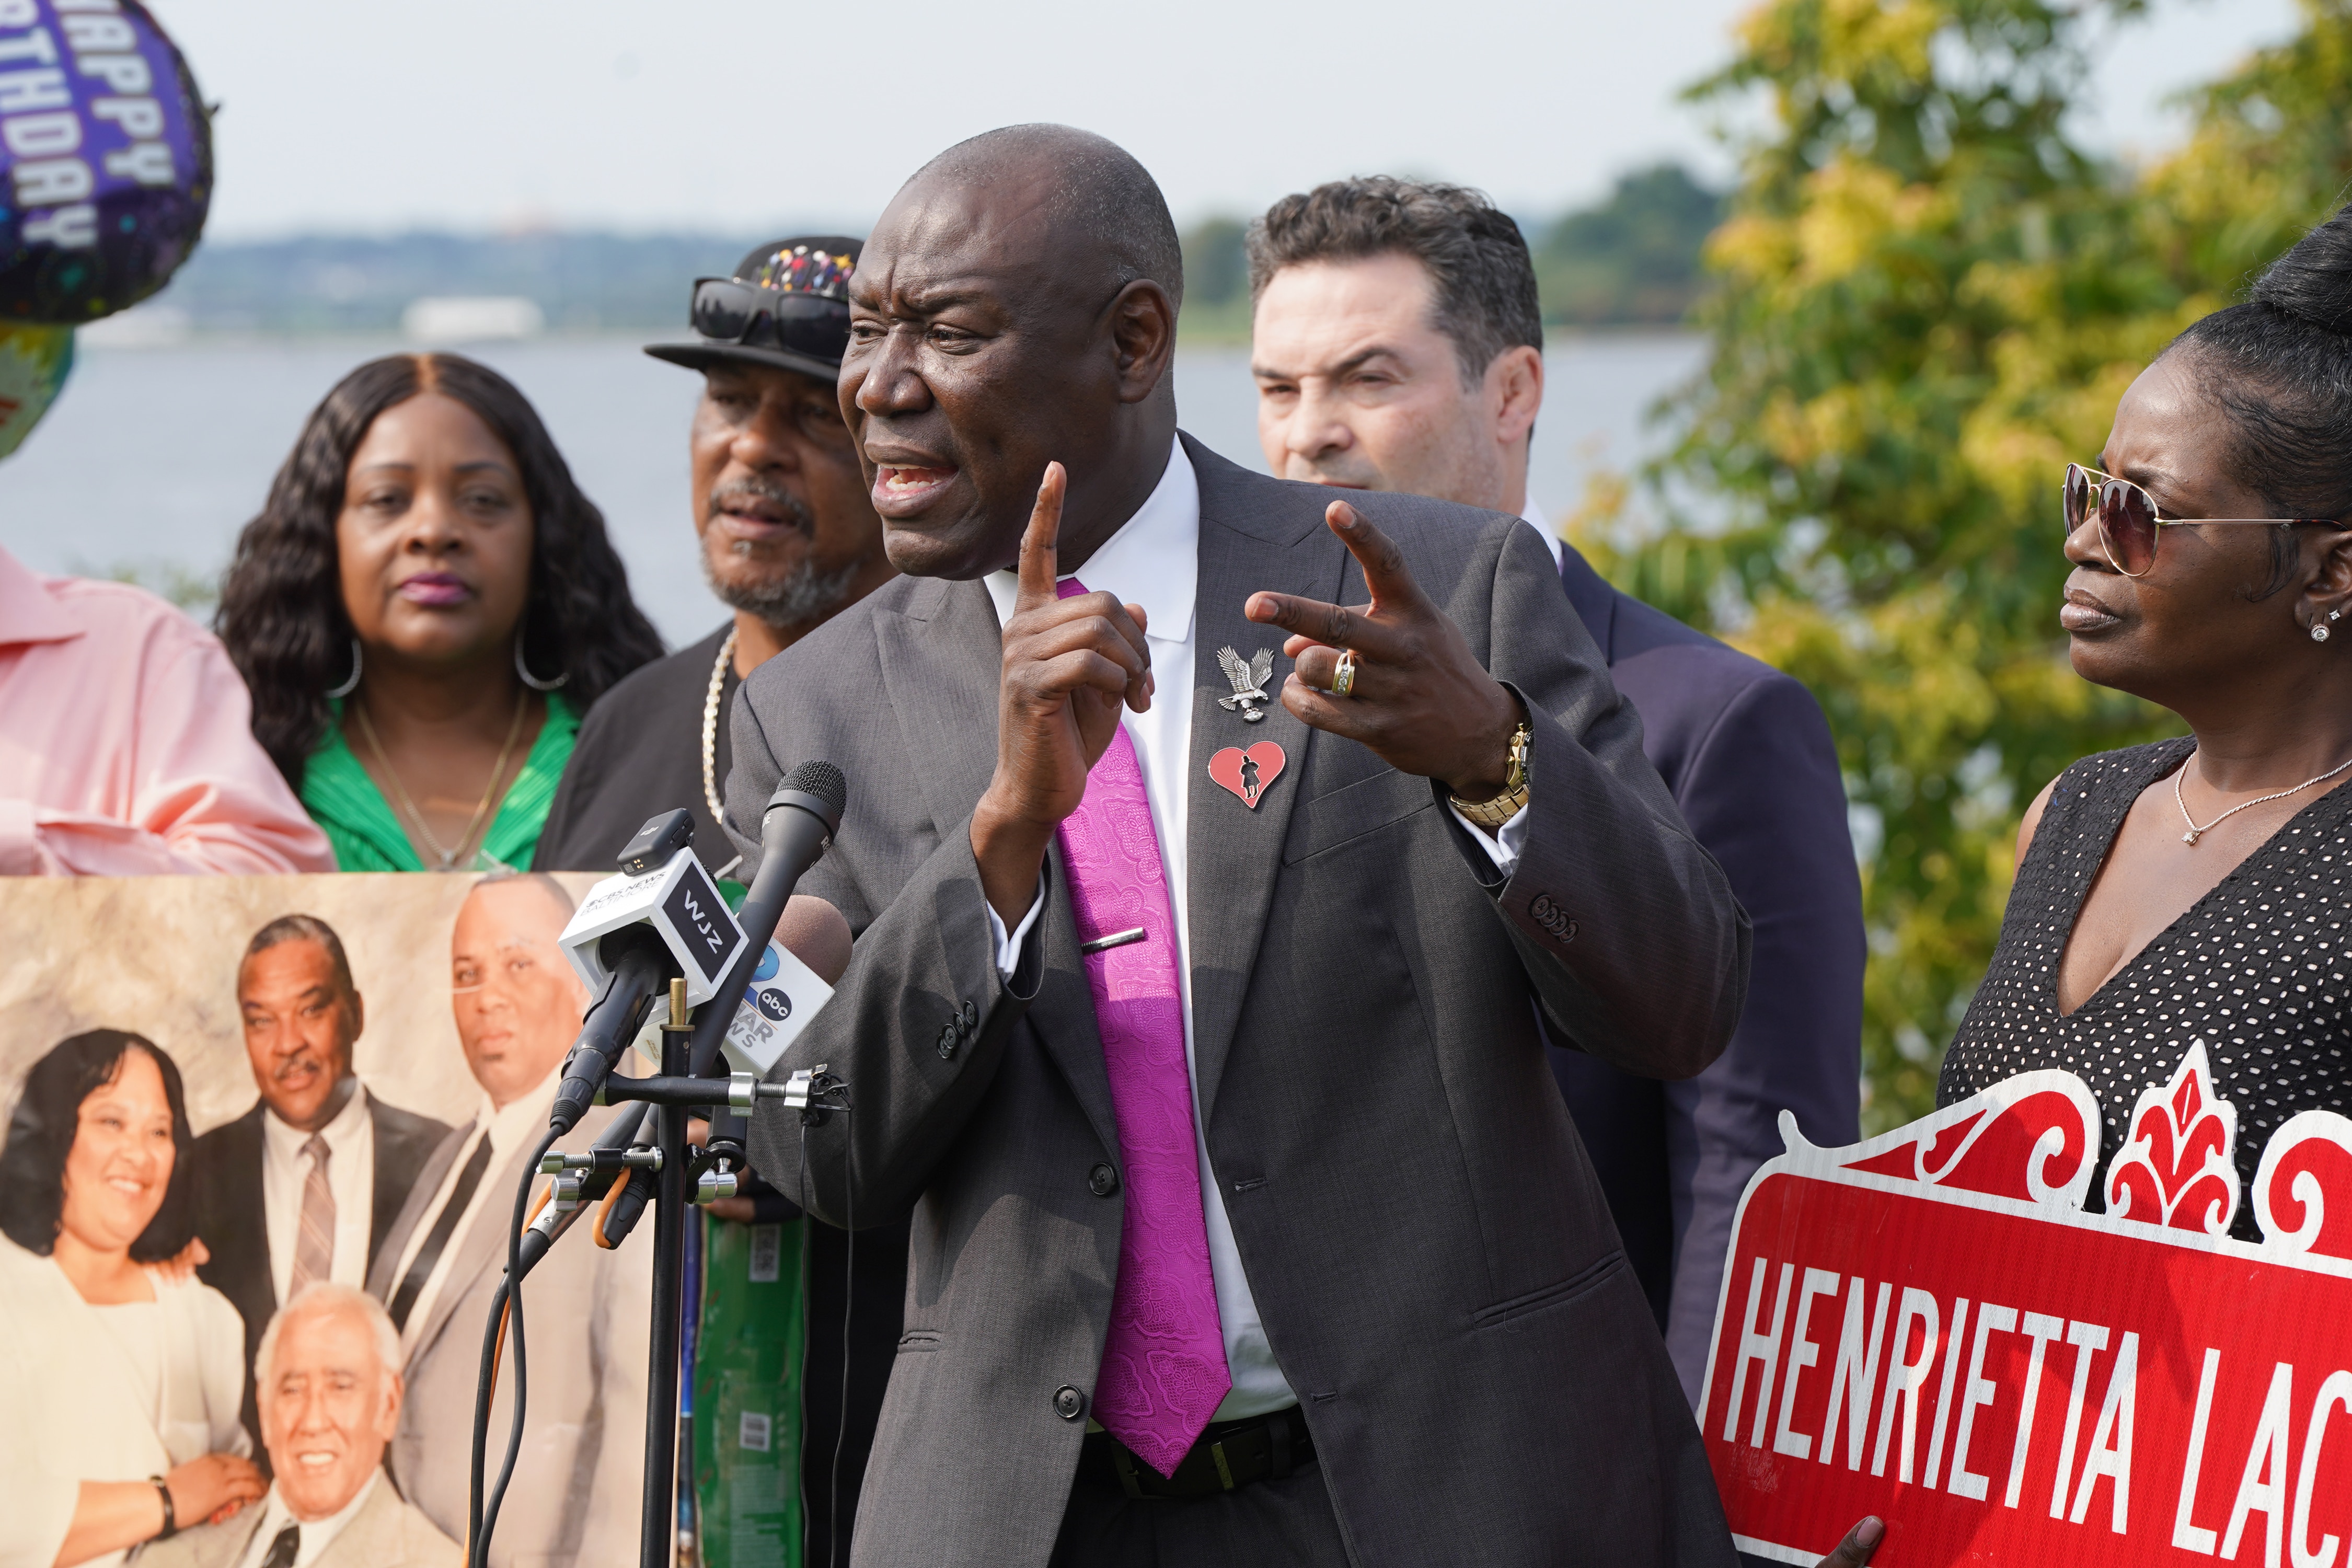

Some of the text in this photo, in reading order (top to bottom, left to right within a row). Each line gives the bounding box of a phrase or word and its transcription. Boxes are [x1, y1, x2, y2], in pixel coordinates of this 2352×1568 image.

[580, 881, 660, 916] BALTIMORE
[598, 871, 666, 903] CBS NEWS
[684, 889, 723, 954] WJZ
[762, 993, 788, 1017] abc
[1722, 1256, 2352, 1568] HENRIETTA LAC
